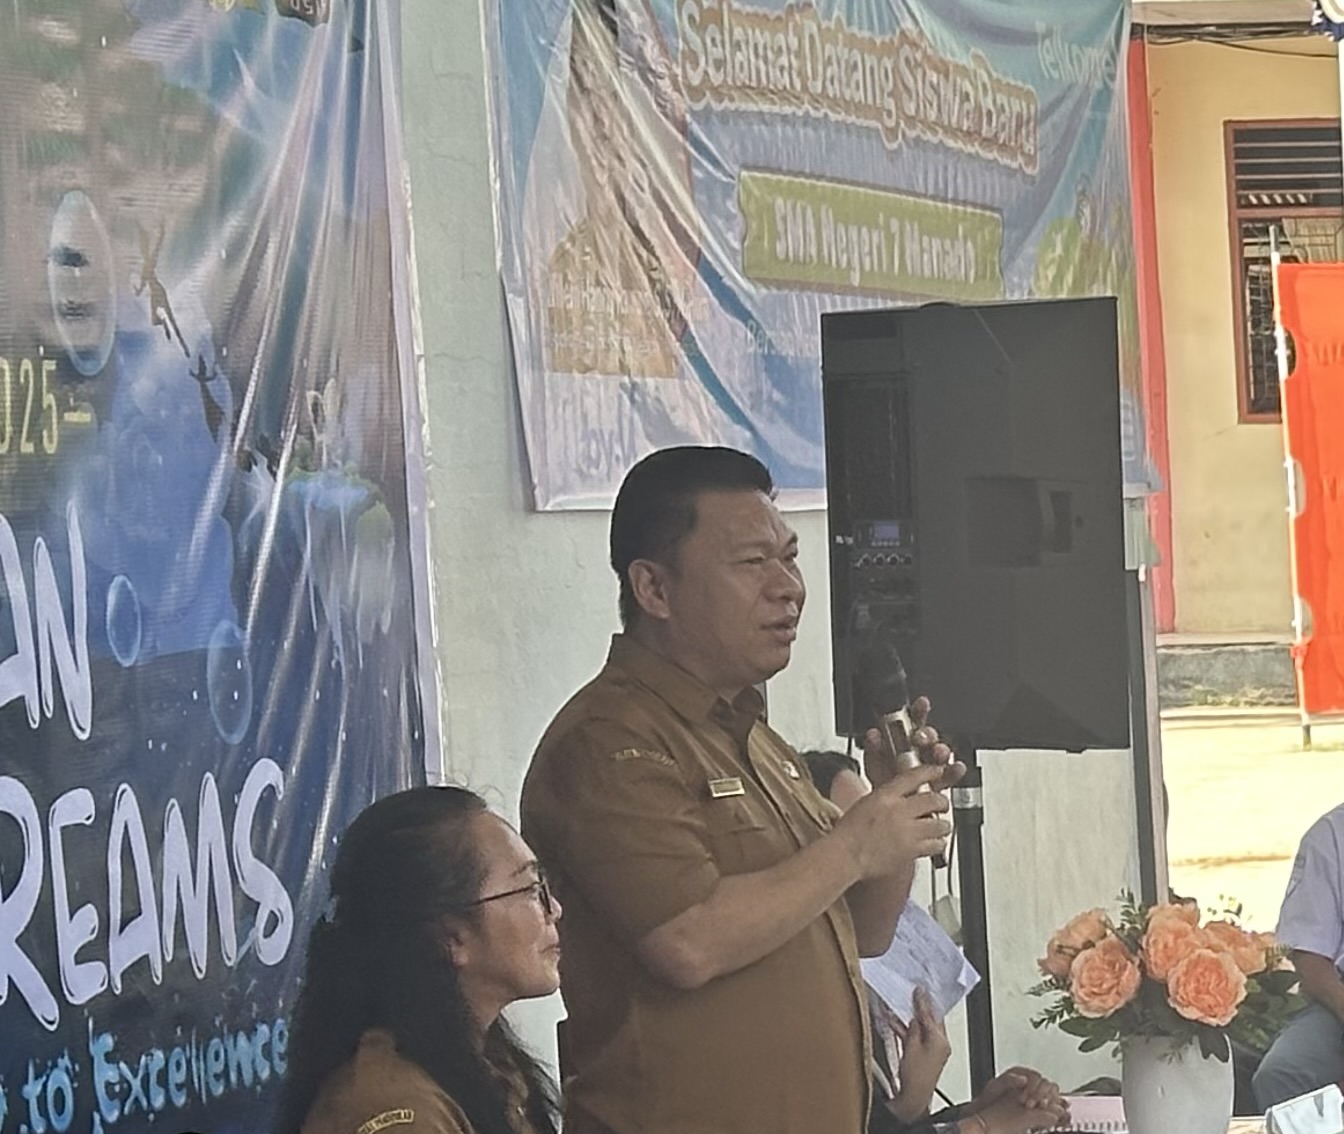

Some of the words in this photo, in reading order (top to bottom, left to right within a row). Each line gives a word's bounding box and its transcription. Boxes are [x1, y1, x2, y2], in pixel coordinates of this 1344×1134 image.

[682, 0, 801, 92] Selamat
[803, 20, 896, 127] Datang
[900, 44, 975, 131] Siswa
[977, 68, 1035, 155] Baru
[775, 196, 818, 265] SMA
[820, 203, 886, 287] Negeri
[904, 219, 975, 285] Manado
[20, 1048, 74, 1134] to
